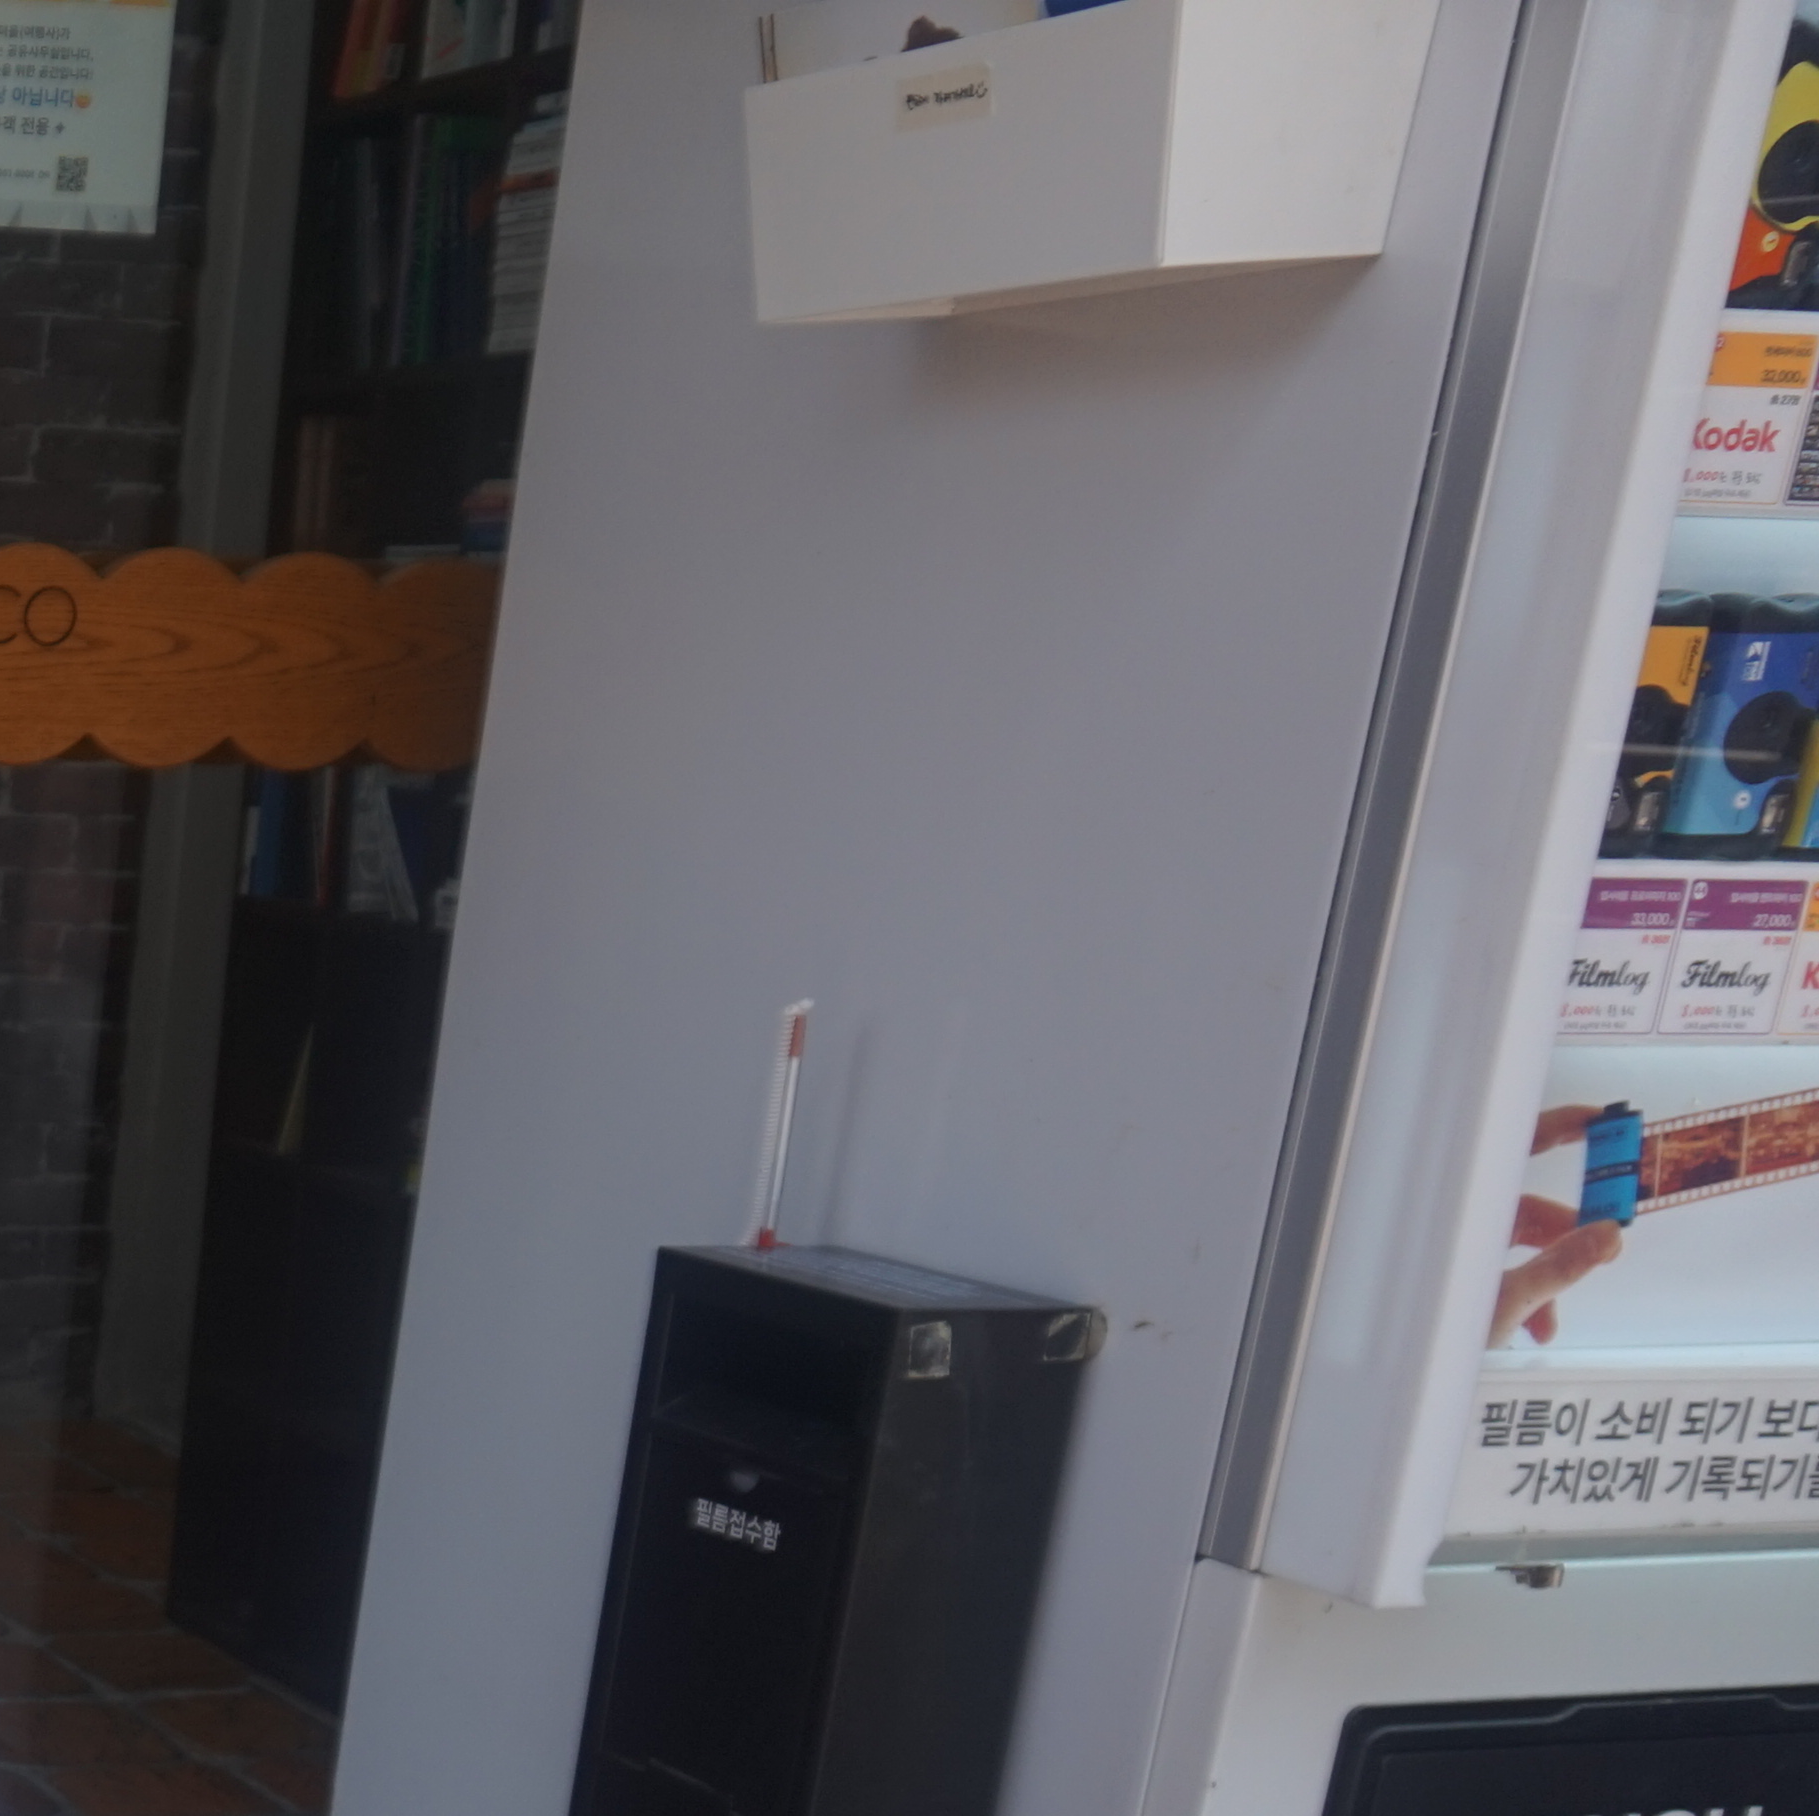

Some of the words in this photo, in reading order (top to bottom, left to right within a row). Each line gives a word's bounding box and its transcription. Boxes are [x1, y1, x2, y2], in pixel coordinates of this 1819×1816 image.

[12, 86, 74, 107] 아닙니다
[21, 116, 50, 136] 전용
[1567, 958, 1651, 996] Filmlog
[1680, 959, 1772, 997] Filmlog
[1481, 1398, 1591, 1447] 필름이
[1594, 1398, 1674, 1445] 소비
[1679, 1397, 1755, 1445] 되기
[1508, 1456, 1661, 1505] 가치있게
[697, 1498, 782, 1552] 필름접수함
